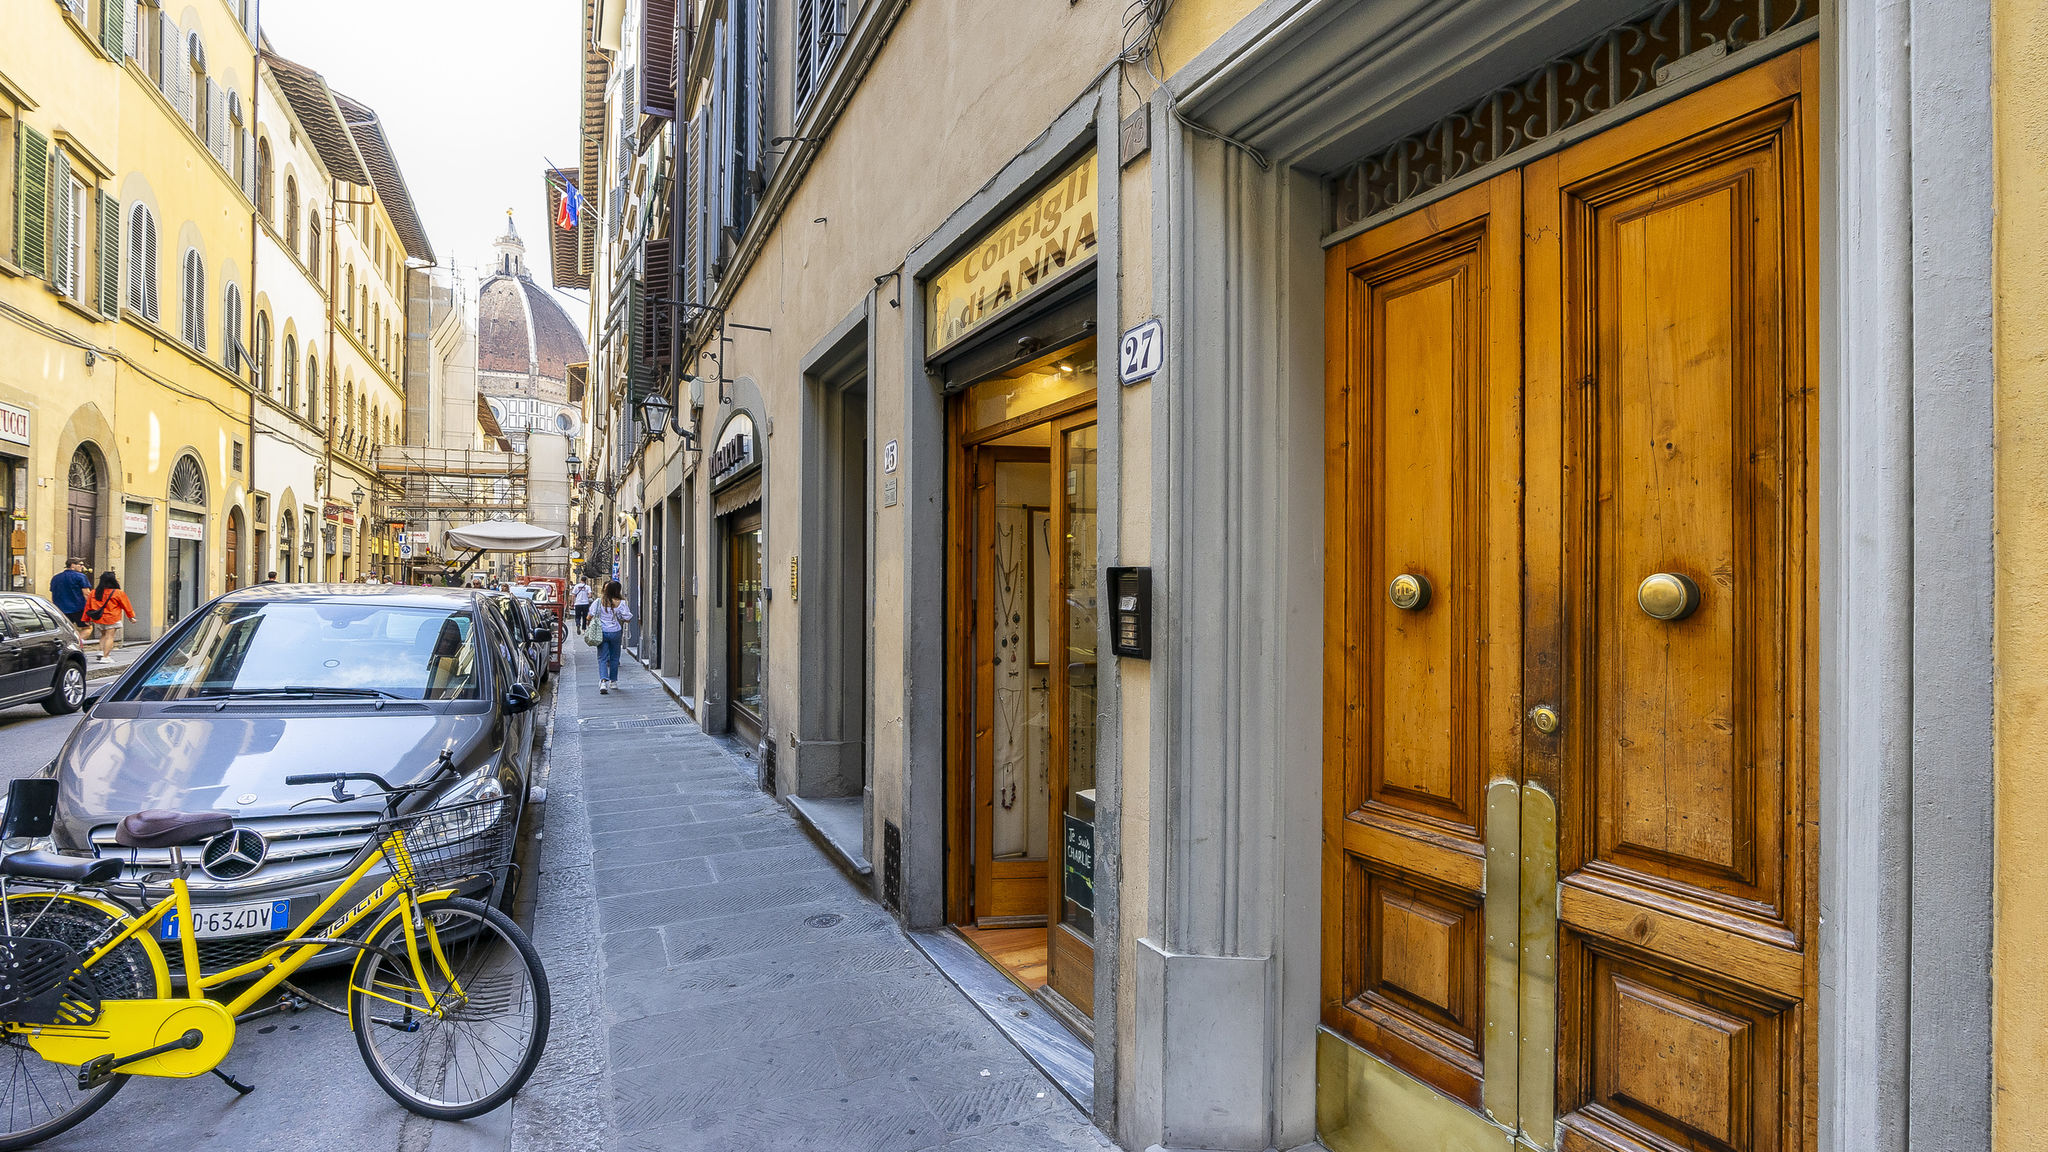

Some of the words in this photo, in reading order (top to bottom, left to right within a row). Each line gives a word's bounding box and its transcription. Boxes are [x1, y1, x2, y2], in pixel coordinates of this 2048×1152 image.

[1122, 116, 1145, 160] 73
[963, 159, 1092, 285] Consigli
[960, 286, 985, 328] di
[991, 211, 1097, 311] ANNA
[1125, 326, 1154, 375] 27
